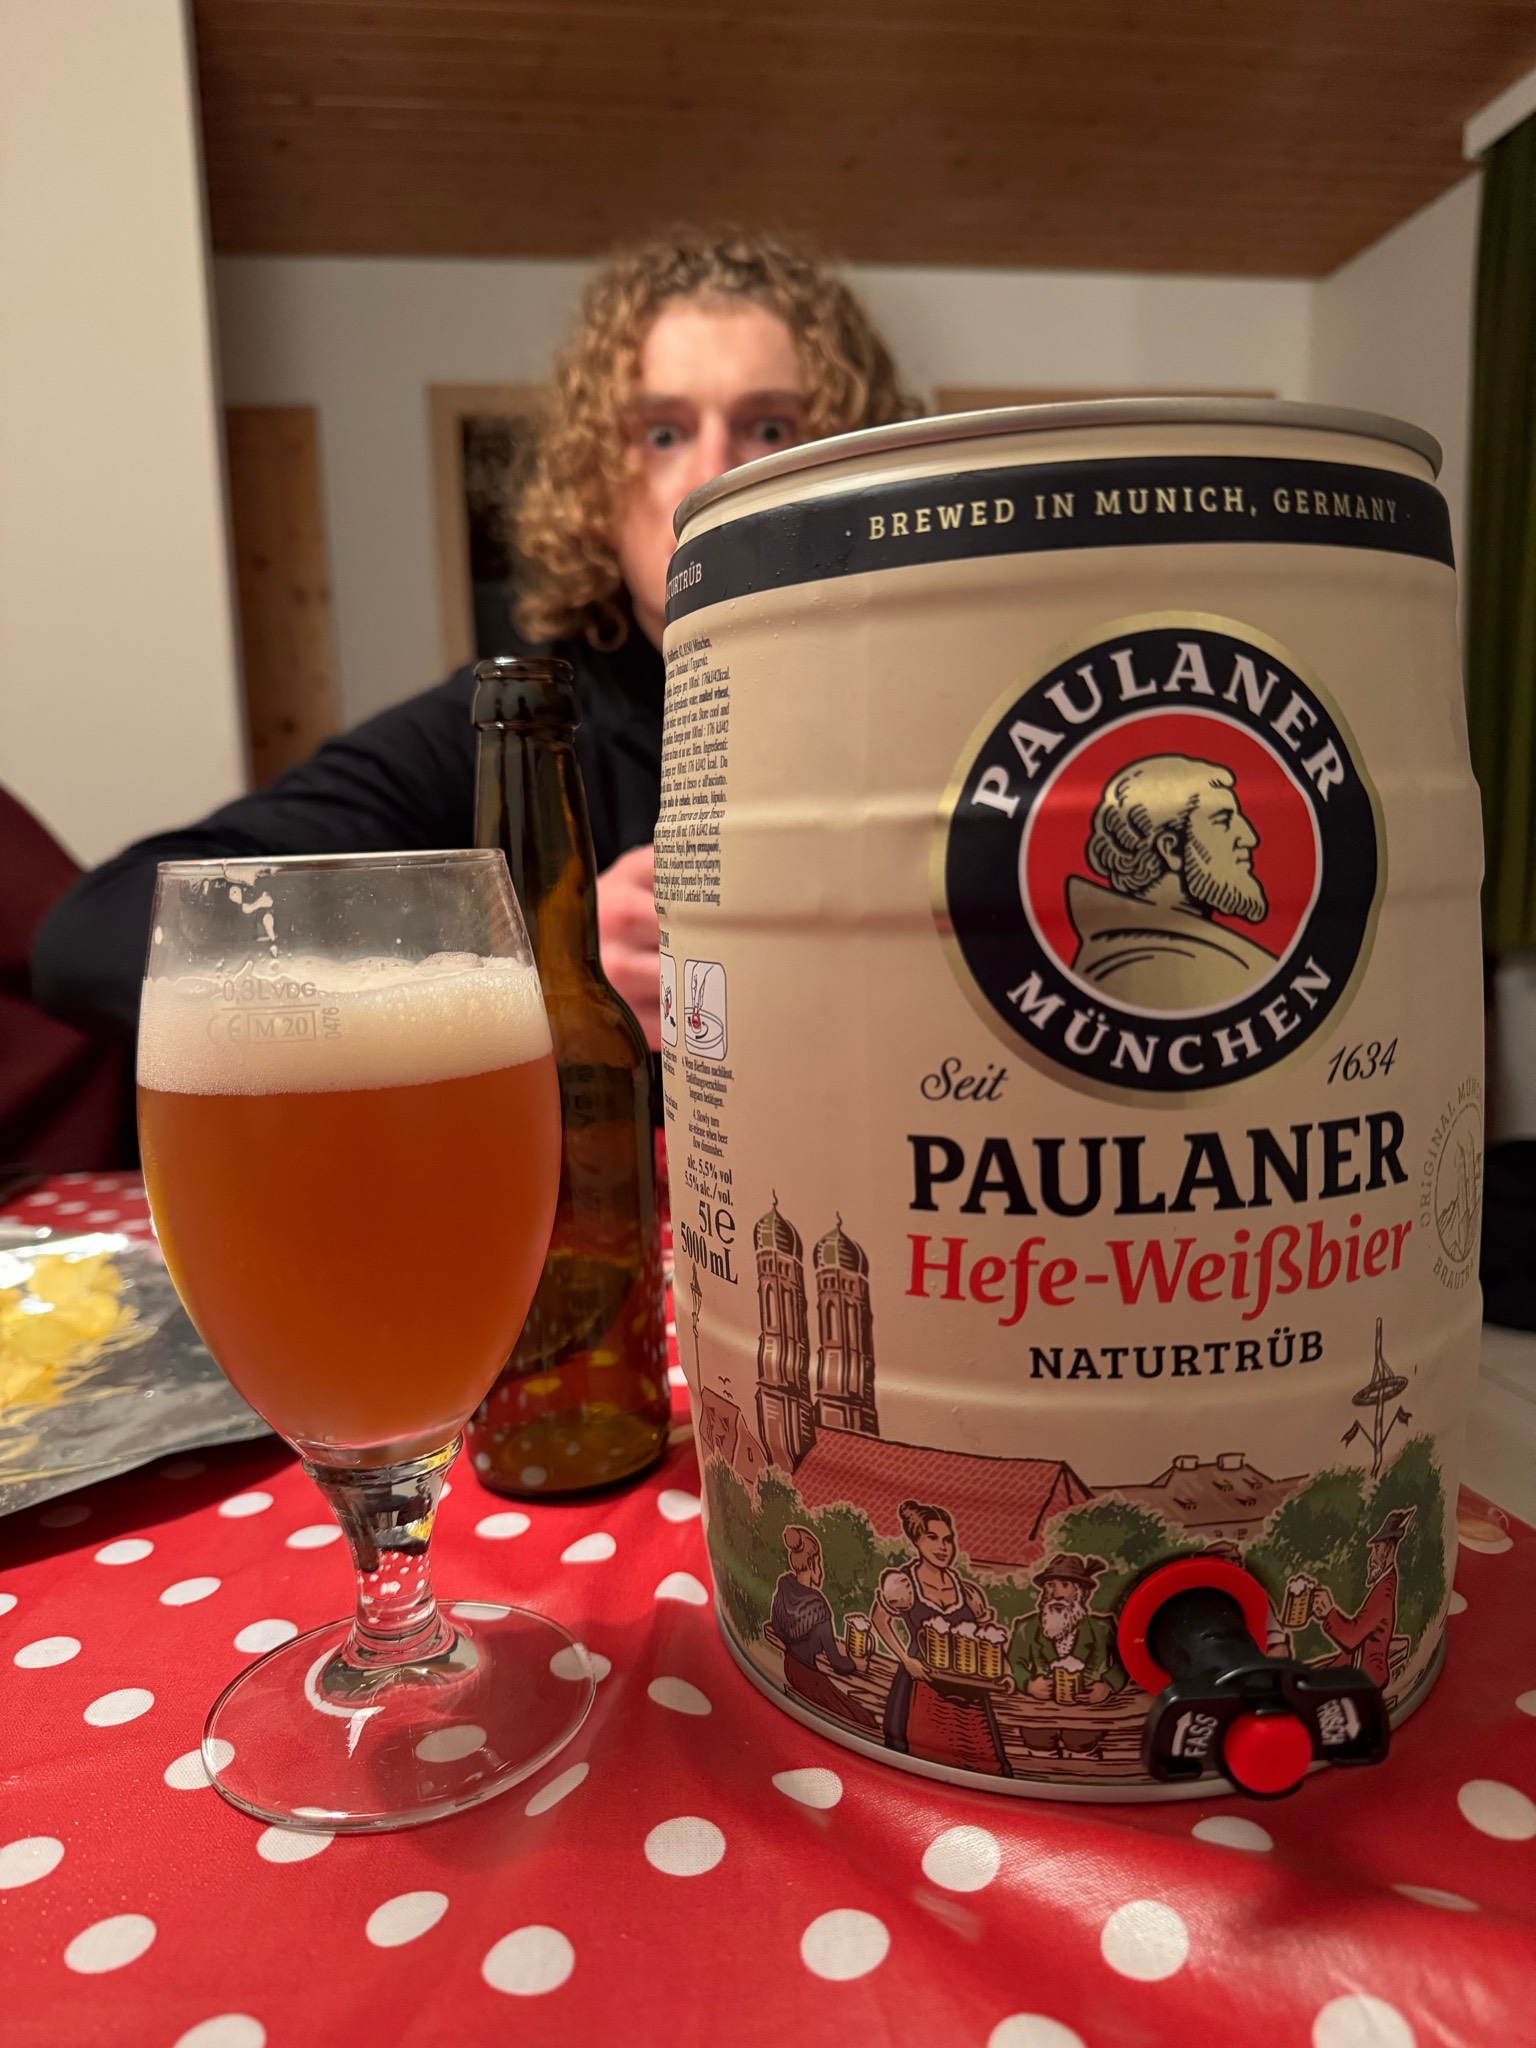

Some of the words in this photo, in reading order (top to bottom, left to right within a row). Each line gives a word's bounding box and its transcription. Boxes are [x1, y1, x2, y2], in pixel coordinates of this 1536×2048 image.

[868, 498, 1016, 541] BREWED
[1034, 493, 1076, 521] IN
[1094, 485, 1258, 518] MUNICH,
[1273, 487, 1398, 524] GERMANY
[970, 641, 1347, 820] PAULANER
[702, 889, 721, 907] Trading
[703, 873, 721, 887] Private
[321, 1006, 342, 1040] 0476
[1006, 955, 1332, 1076] MÜNCHEN
[919, 1056, 1011, 1102] Seit
[1326, 1037, 1399, 1087] 1634
[687, 1153, 697, 1172] alc.
[698, 1158, 718, 1180] 5,5%
[719, 1169, 733, 1185] vol
[906, 1110, 1409, 1218] PAULANER
[717, 1189, 734, 1206] vol.
[680, 1221, 708, 1270] 5000
[709, 1246, 739, 1286] mL
[904, 1213, 1413, 1327] Hefe-Weißbier
[1029, 1327, 1325, 1380] NATURTRÜB
[1183, 1711, 1219, 1759] FASS
